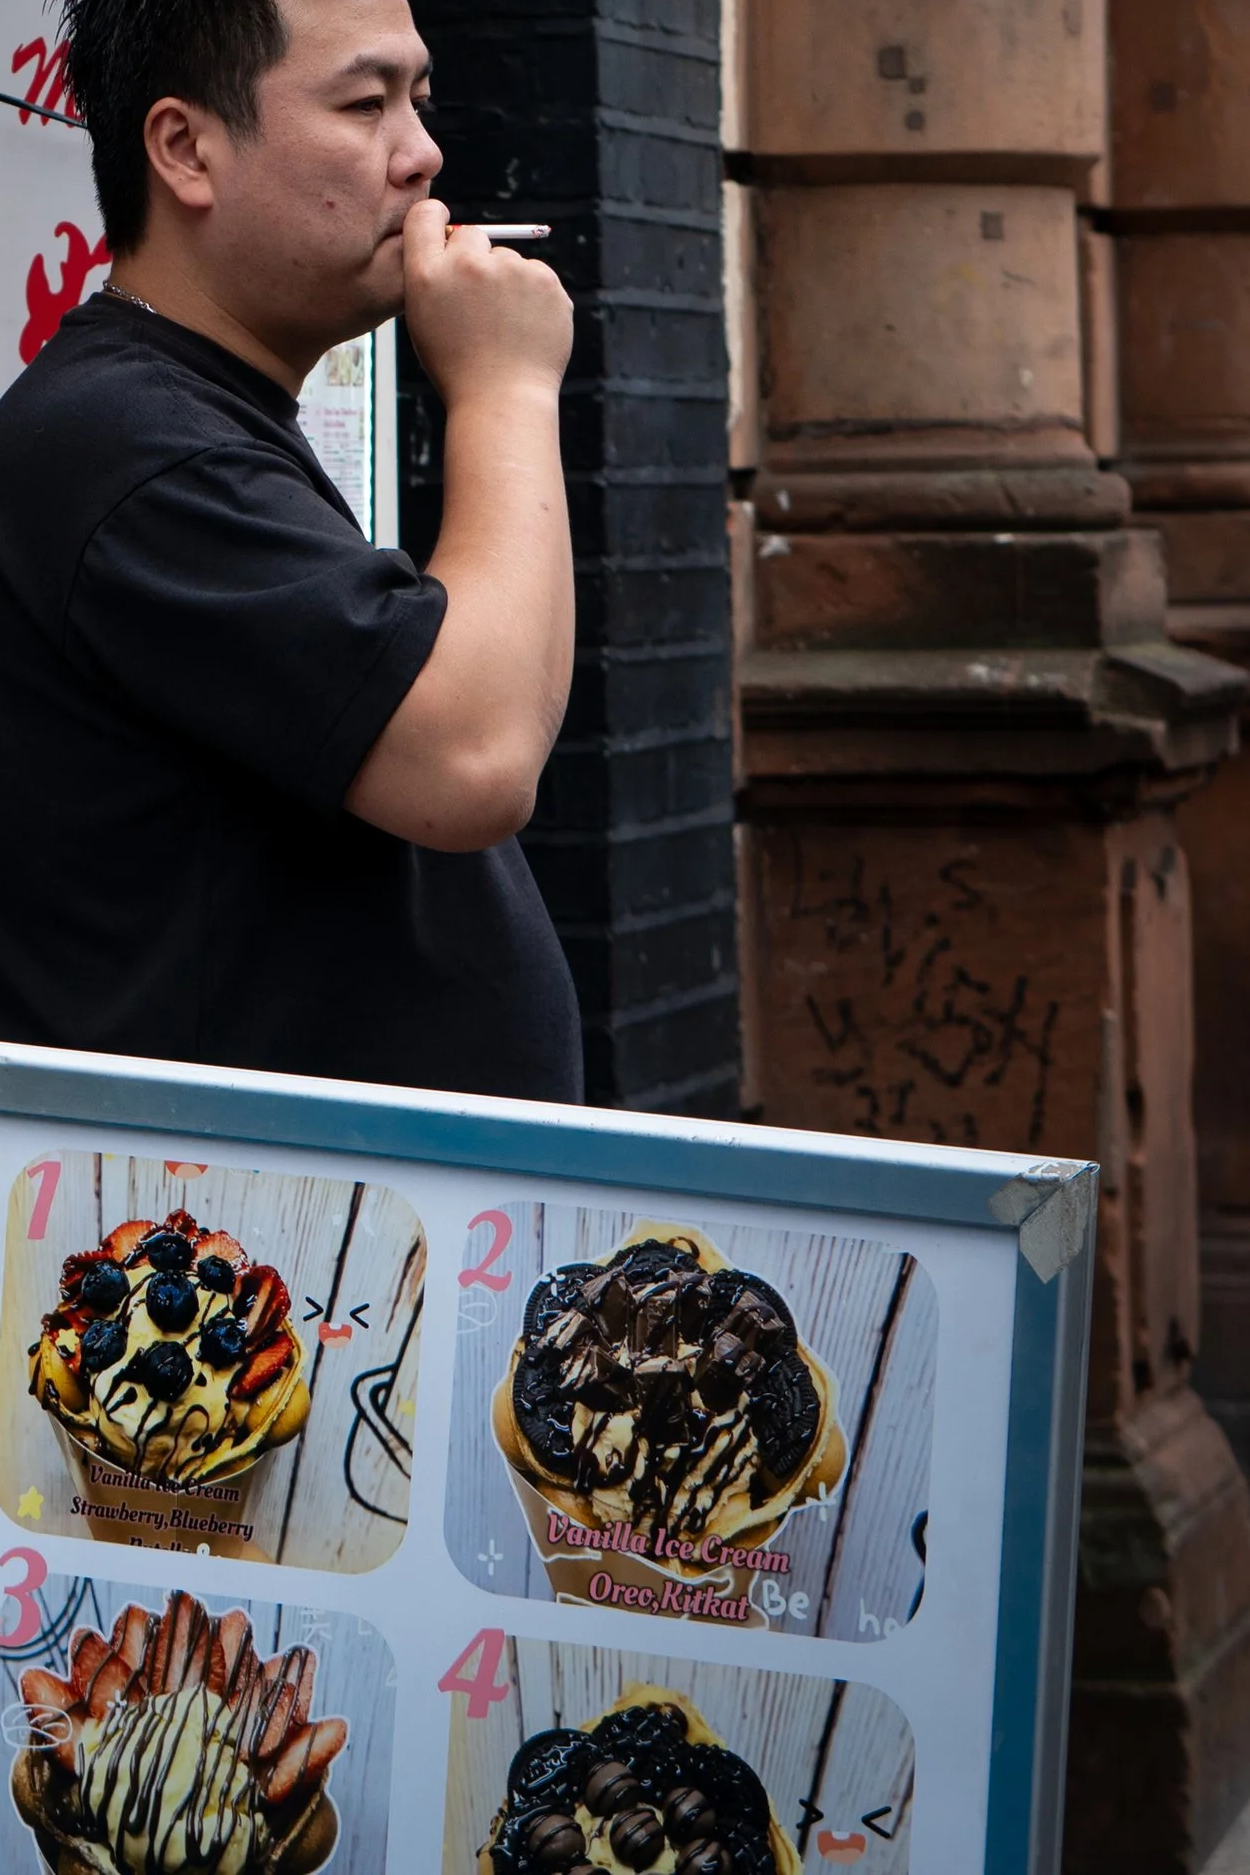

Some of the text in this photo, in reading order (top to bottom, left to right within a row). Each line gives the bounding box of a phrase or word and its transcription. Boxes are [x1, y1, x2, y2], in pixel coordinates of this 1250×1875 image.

[26, 1160, 62, 1240] 1
[458, 1209, 513, 1293] 2
[90, 1465, 151, 1490] Vanilla
[184, 1477, 240, 1502] Cream
[548, 1513, 647, 1554] Vanilla
[700, 1535, 791, 1574] Cream
[762, 1579, 810, 1620] Be
[438, 1628, 510, 1719] 4
